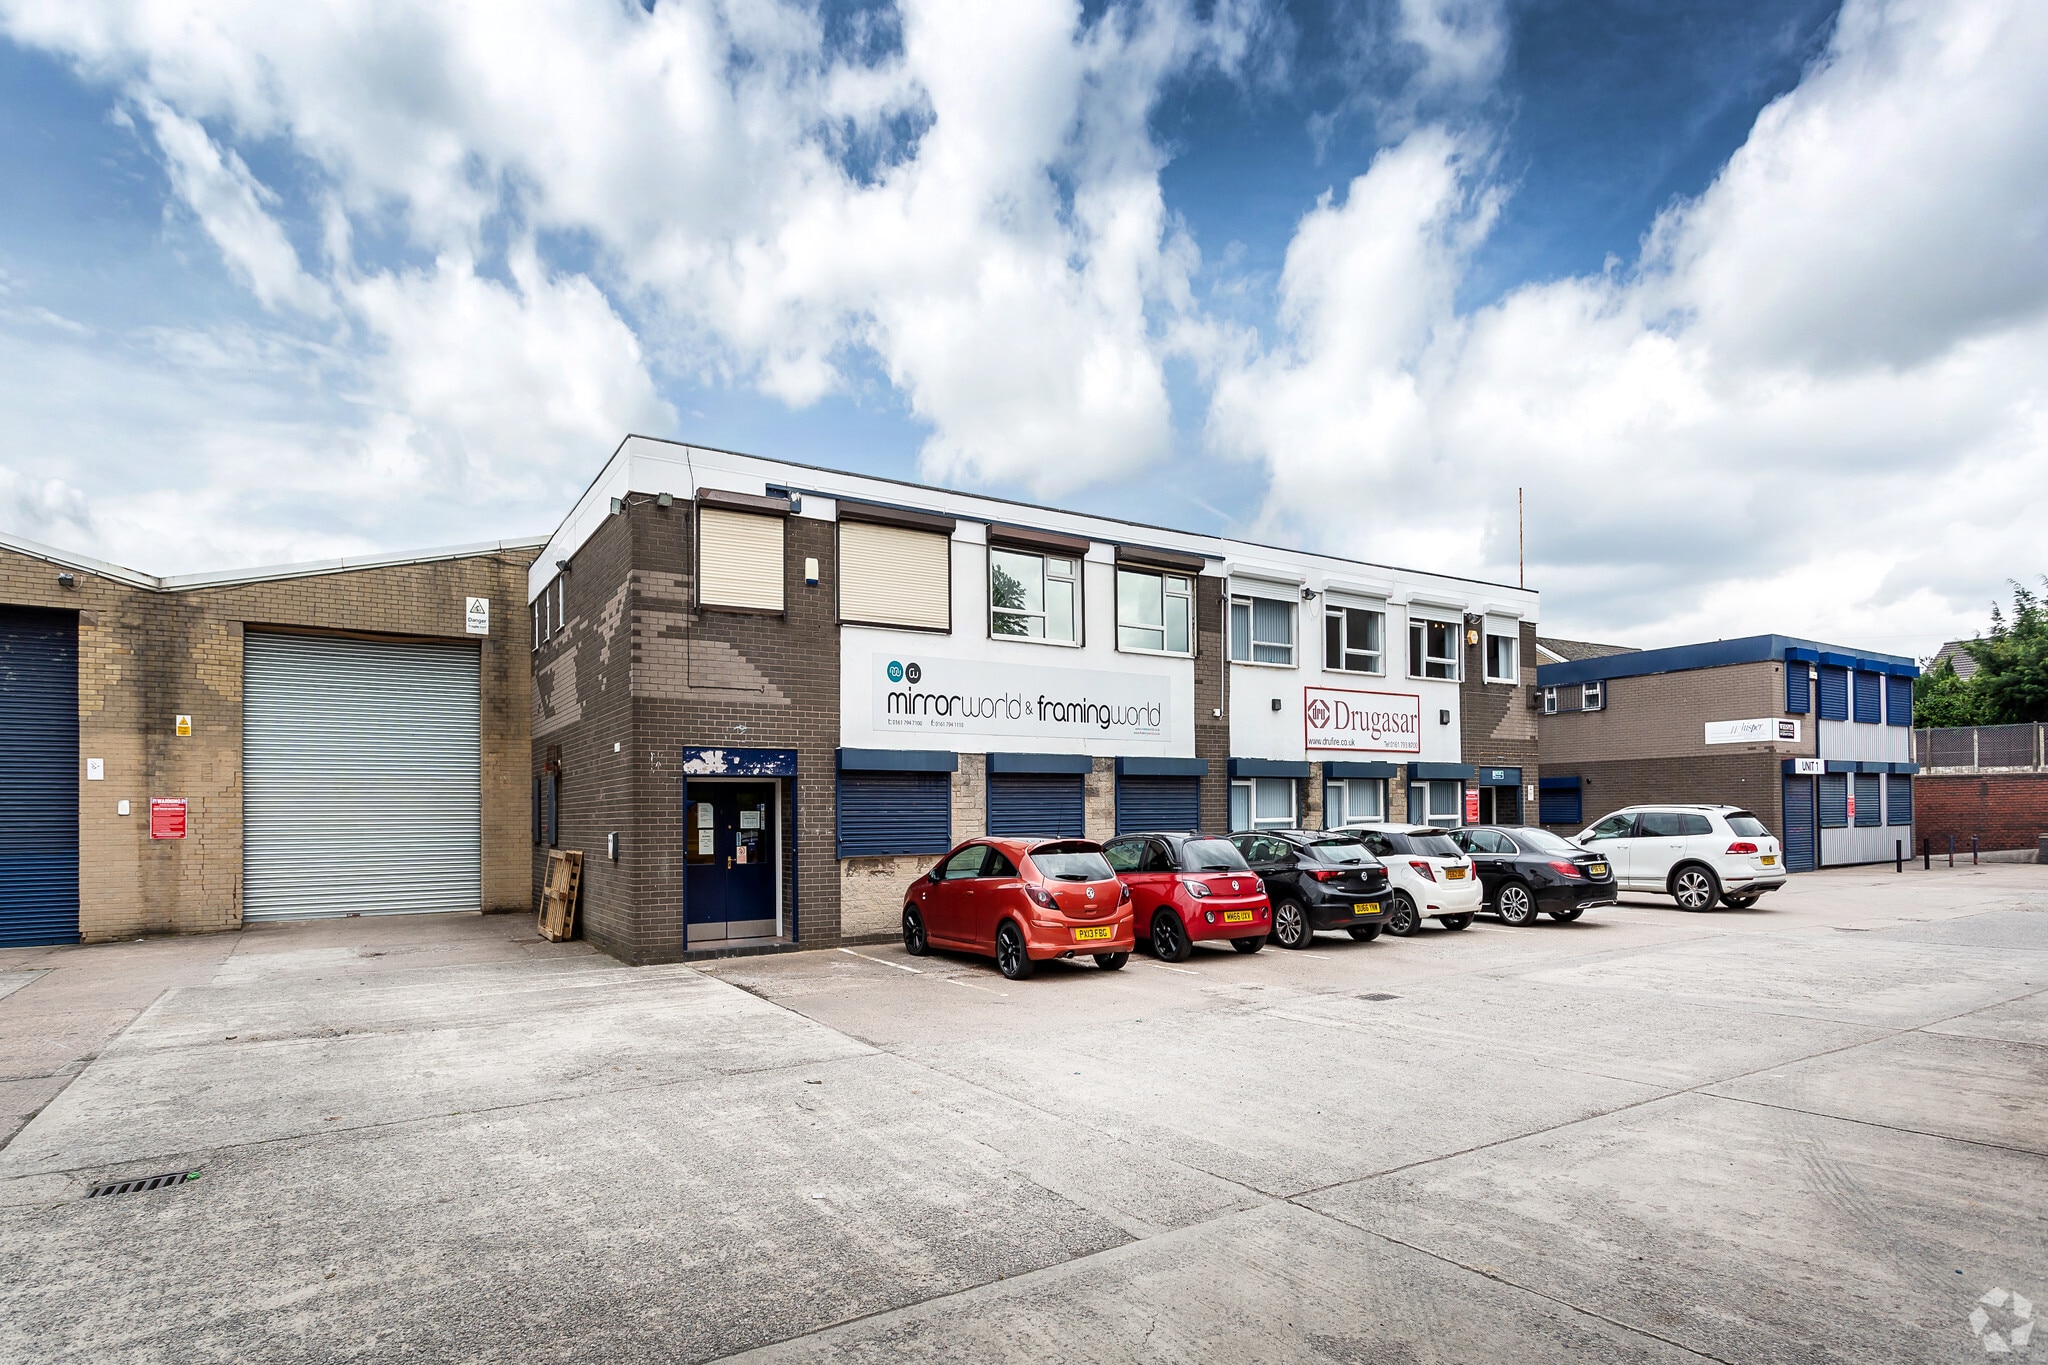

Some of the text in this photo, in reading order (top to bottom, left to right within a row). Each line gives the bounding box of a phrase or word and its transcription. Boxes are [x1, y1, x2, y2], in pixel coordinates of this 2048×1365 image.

[888, 686, 1161, 729] mirrorworld & framingworld
[1333, 700, 1418, 740] Drugasar
[1308, 738, 1355, 747] www.drufire.co.uk
[1802, 761, 1819, 772] UNIT 1
[1079, 928, 1107, 938] PX13 FBG
